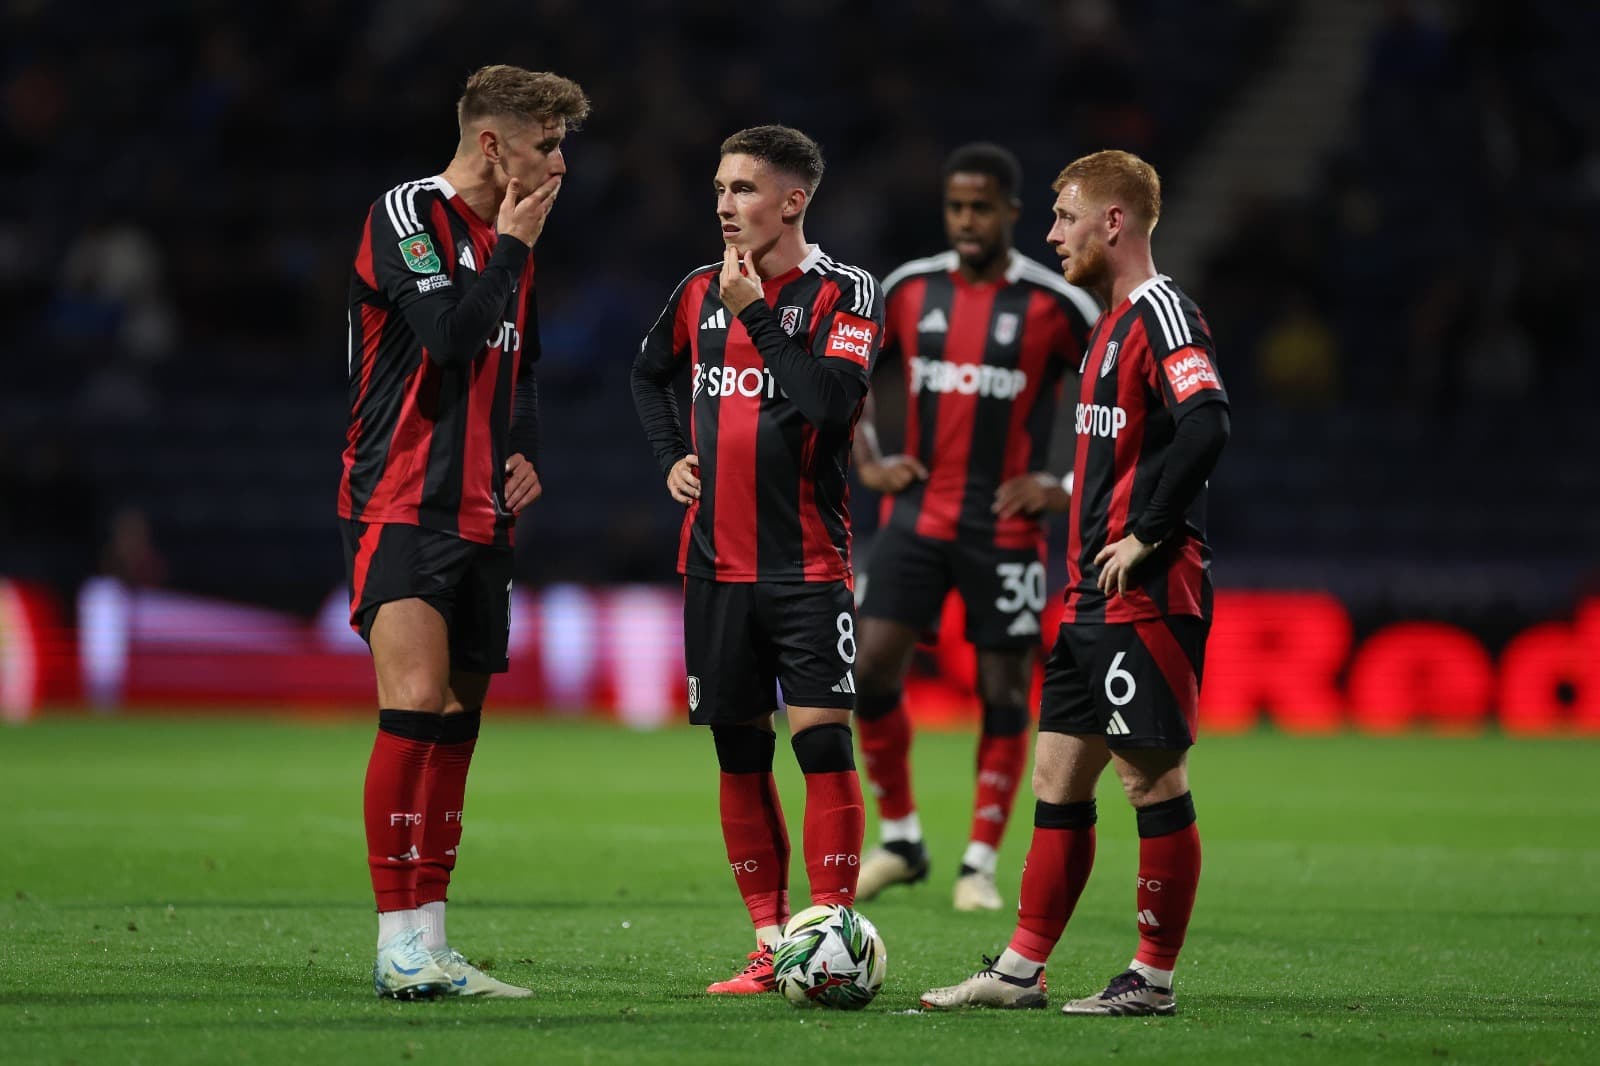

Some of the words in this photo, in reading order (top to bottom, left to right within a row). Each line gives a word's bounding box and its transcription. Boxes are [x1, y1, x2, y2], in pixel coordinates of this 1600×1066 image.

[416, 278, 430, 288] No
[838, 321, 873, 344] Web
[1169, 354, 1208, 377] Web
[994, 560, 1047, 614] 30
[836, 611, 857, 665] 8
[1104, 651, 1136, 706] 6
[390, 812, 423, 827] FFC
[823, 854, 859, 868] FFC
